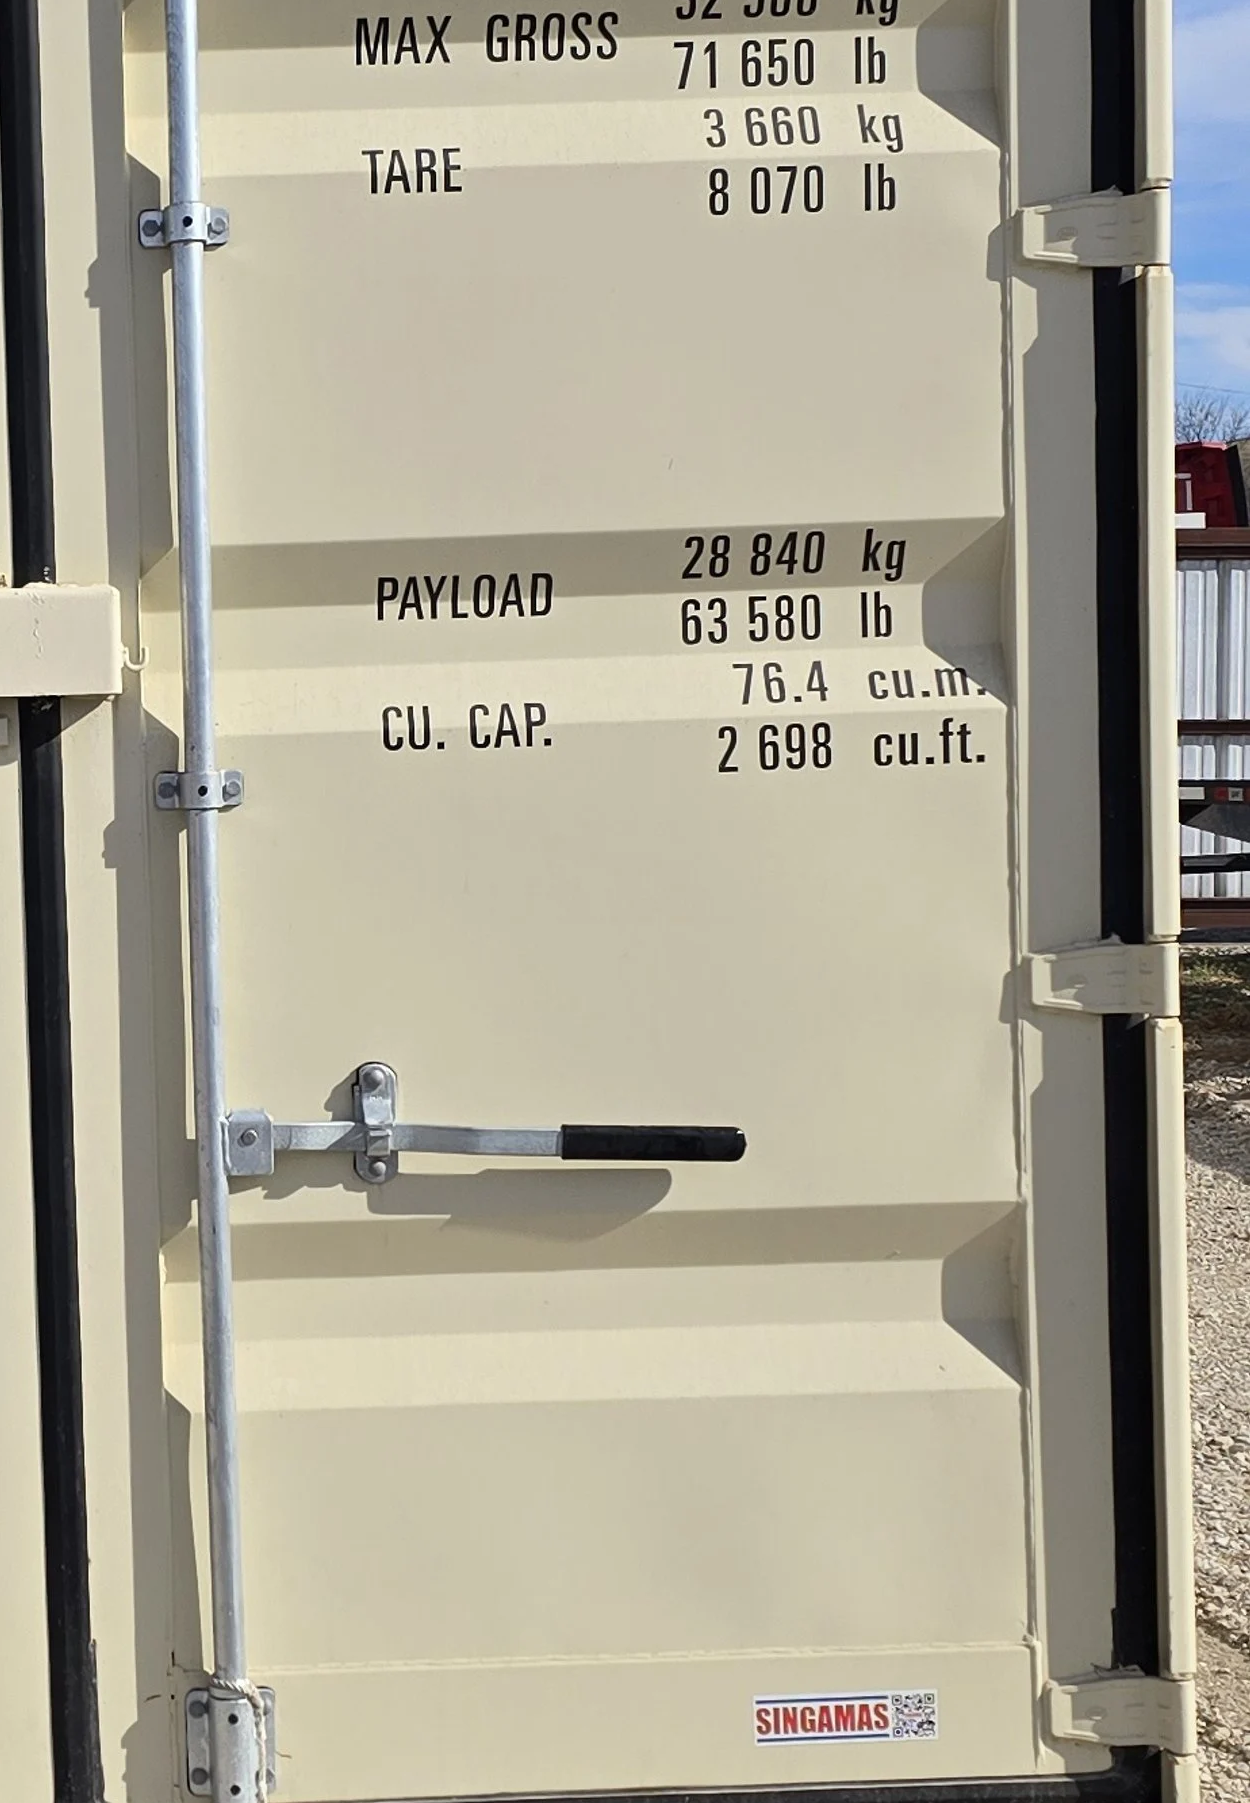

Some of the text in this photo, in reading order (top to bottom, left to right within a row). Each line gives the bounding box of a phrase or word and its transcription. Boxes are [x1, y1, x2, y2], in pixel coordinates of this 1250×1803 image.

[355, 11, 619, 66] MAX GROSS
[673, 36, 886, 90] 71 650 lb
[703, 103, 904, 154] 3 660 kg
[361, 147, 463, 195] TARE
[708, 162, 896, 216] 8 070 lb
[681, 528, 907, 582] 28 840 kg
[377, 572, 554, 622] PAYLOAD
[680, 590, 893, 646] 63 580 lb
[731, 659, 987, 706] 76.4 cu.m.
[381, 702, 553, 752] CU. CAP.
[717, 717, 987, 773] 2 698 cu.ft.
[755, 1703, 890, 1736] SINGAMAS
